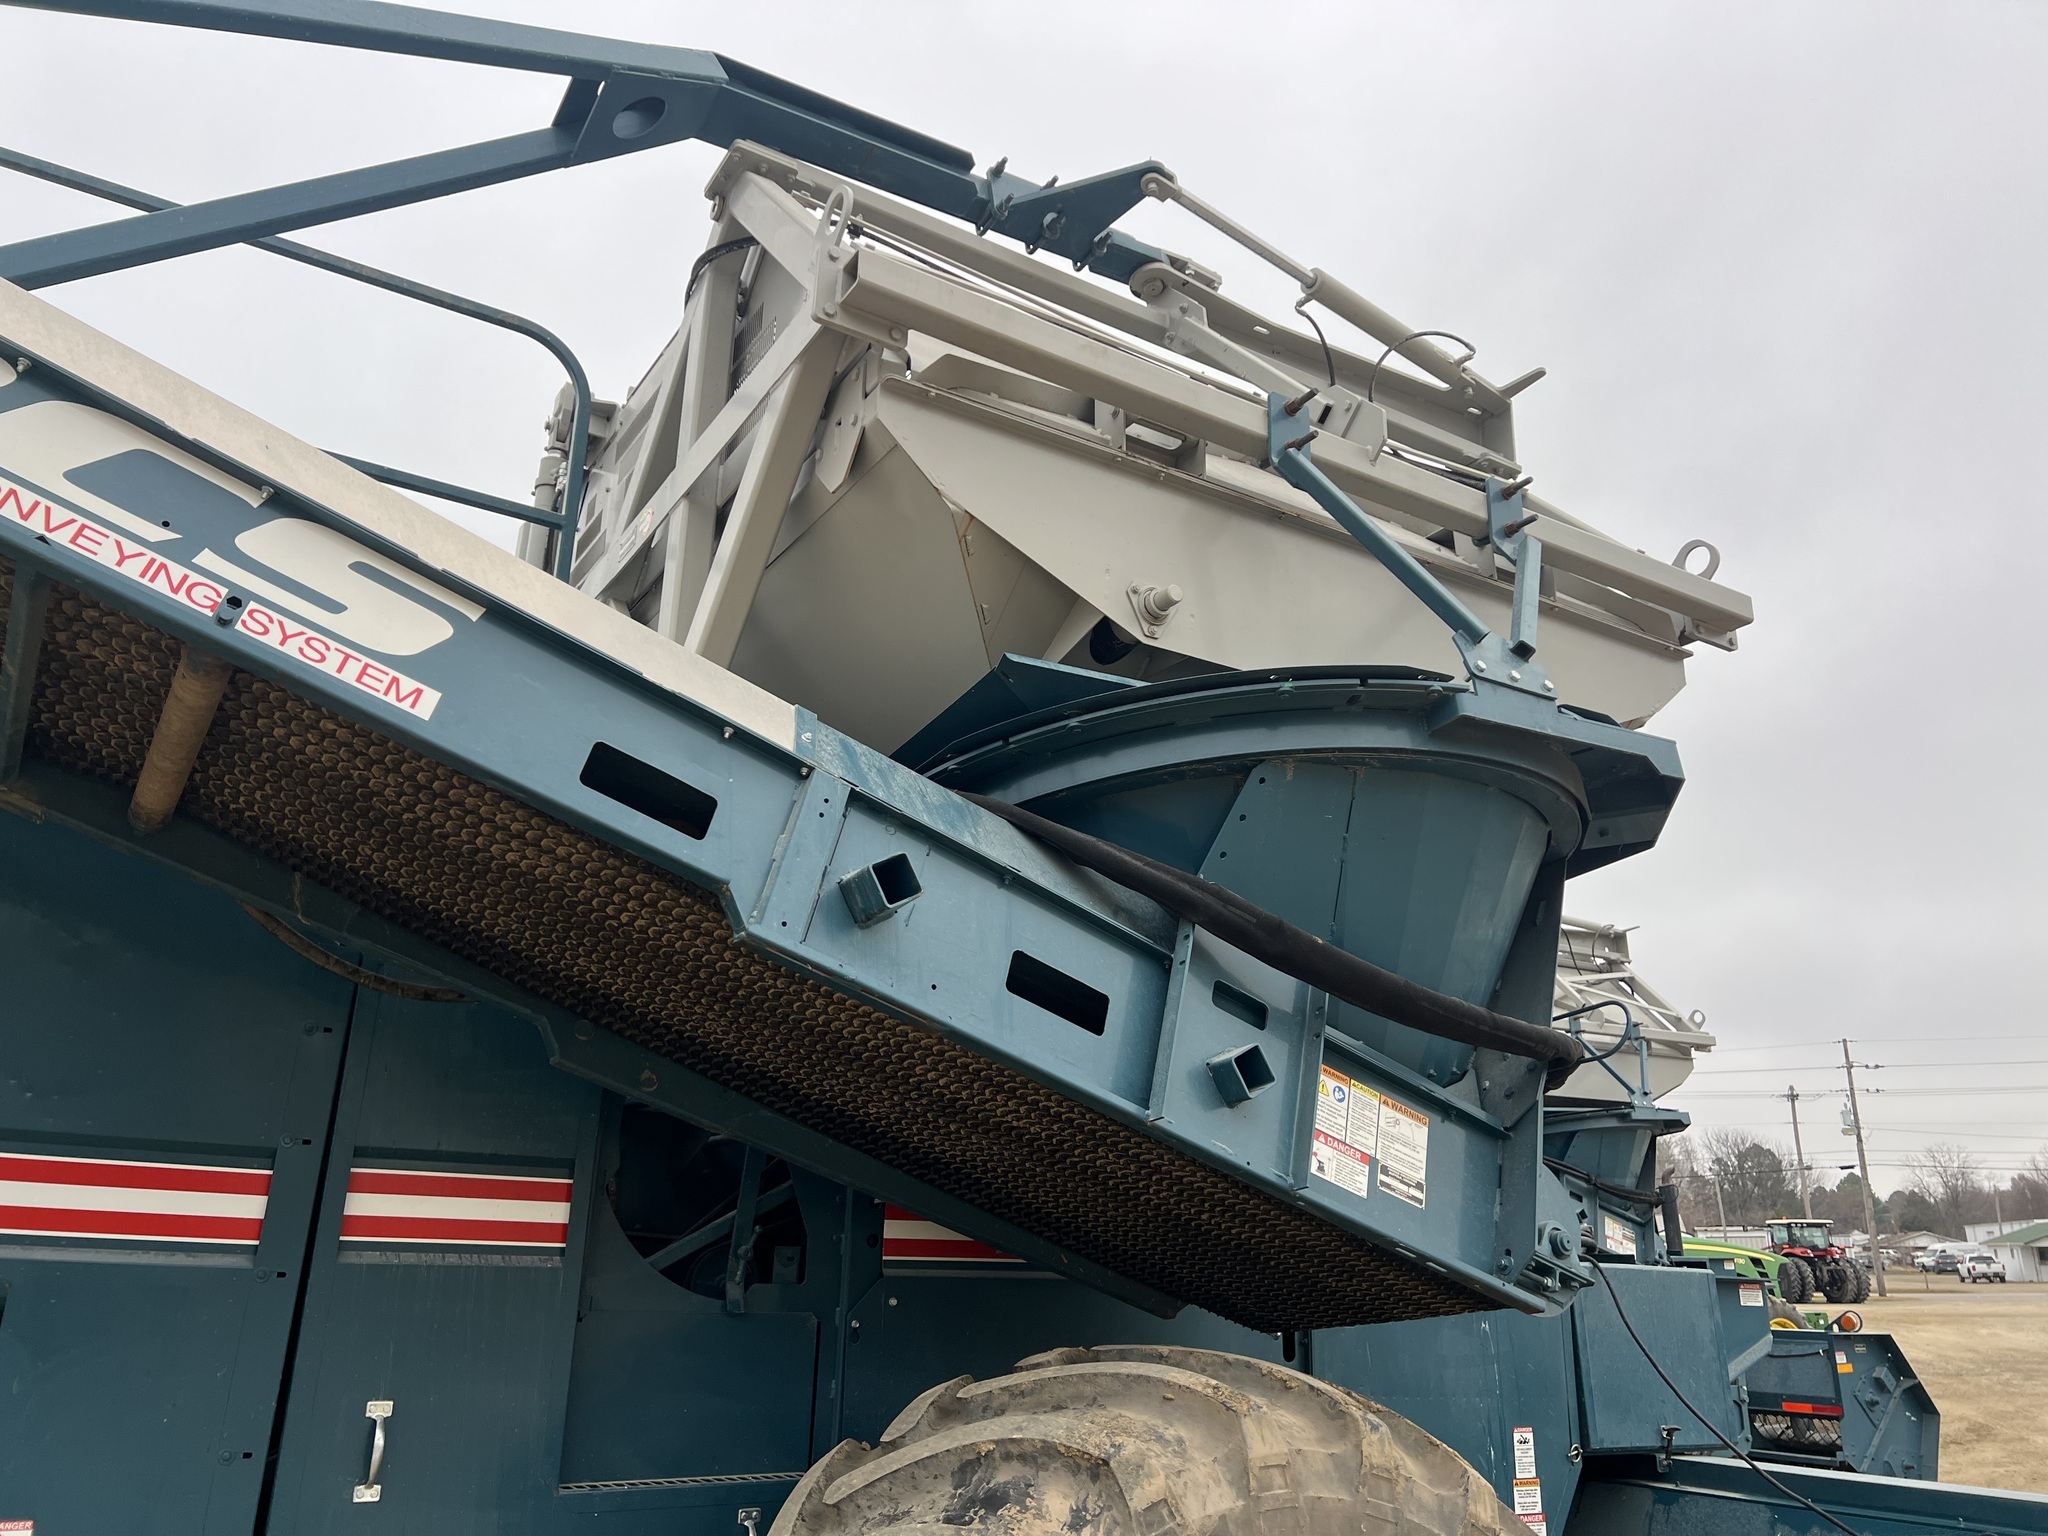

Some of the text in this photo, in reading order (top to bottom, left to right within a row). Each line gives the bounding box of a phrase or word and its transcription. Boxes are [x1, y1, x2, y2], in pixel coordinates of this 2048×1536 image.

[0, 486, 425, 711] NVEYING SYSTEM
[1322, 1066, 1349, 1085] WARNING
[1356, 1084, 1379, 1099] CAUTION
[1391, 1101, 1428, 1126] WARNING
[1327, 1136, 1362, 1162] DANGER
[1519, 1514, 1544, 1523] DANGER
